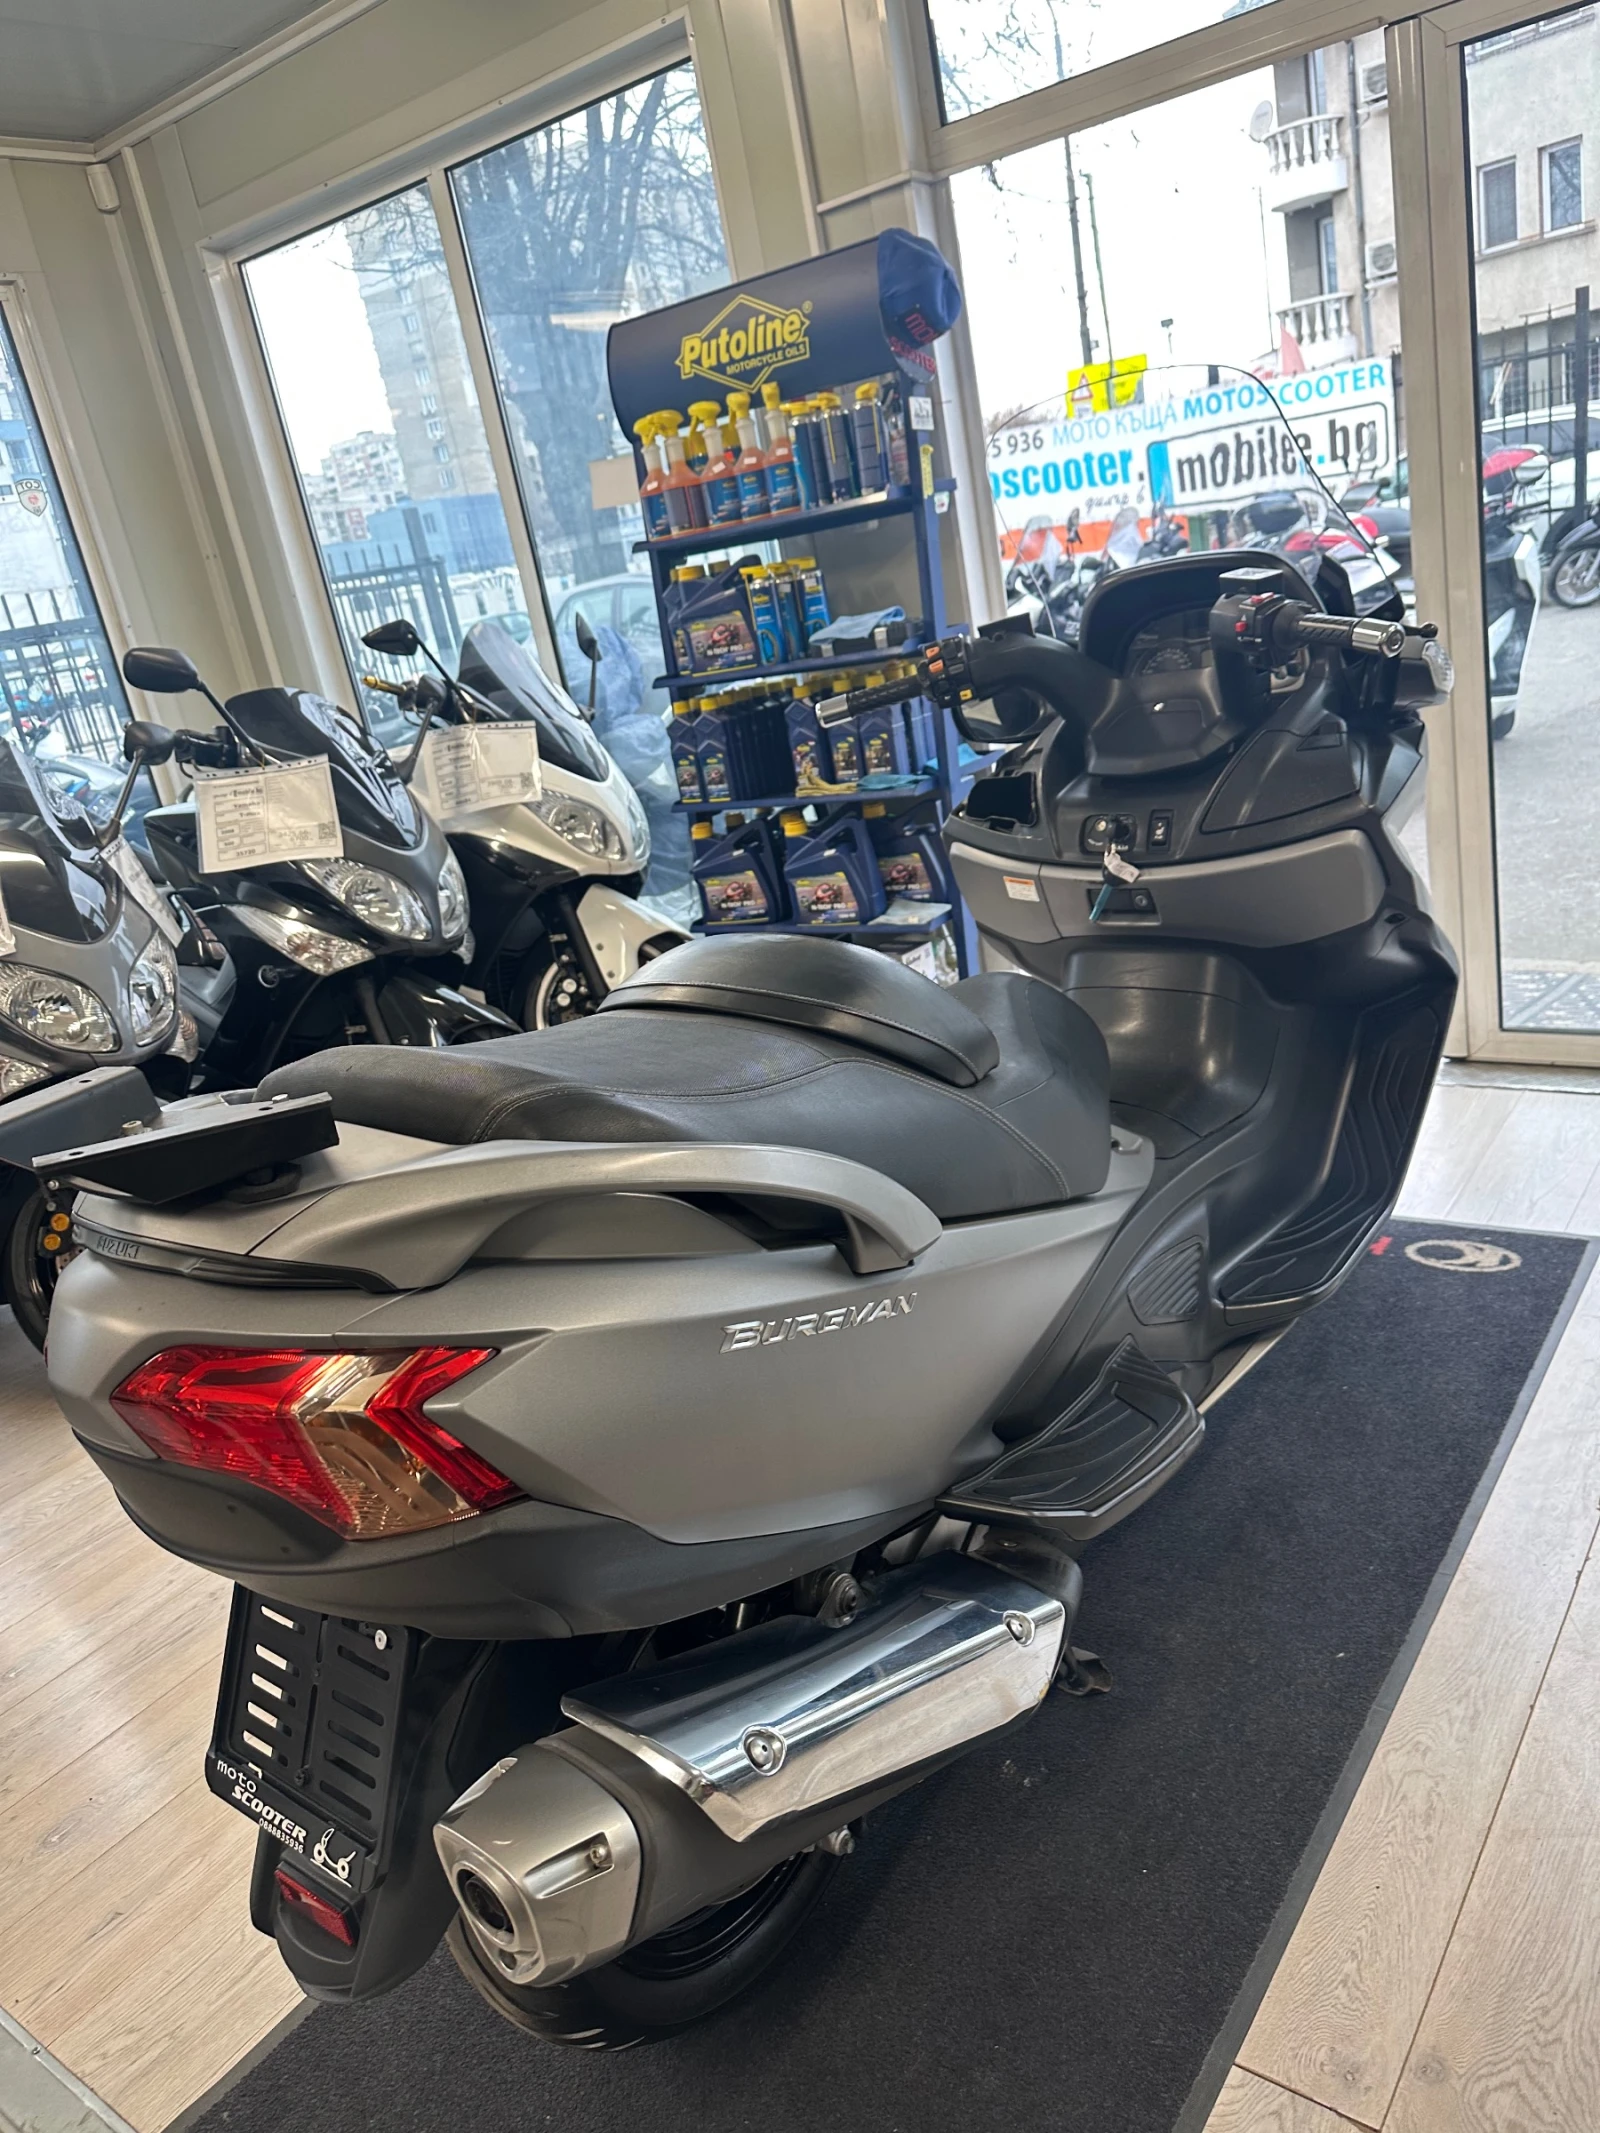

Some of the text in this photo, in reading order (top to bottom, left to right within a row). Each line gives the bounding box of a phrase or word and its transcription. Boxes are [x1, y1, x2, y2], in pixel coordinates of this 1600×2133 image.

[683, 313, 801, 375] Putoline
[726, 344, 806, 375] MOTORCYCLE OILS
[1007, 430, 1044, 455] 936
[1116, 403, 1177, 434] КЪЩА
[719, 1291, 918, 1354] BURGMAN
[217, 1759, 257, 1793] moto
[231, 1785, 307, 1844] SCOOTER
[258, 1818, 304, 1854] 0888835936
